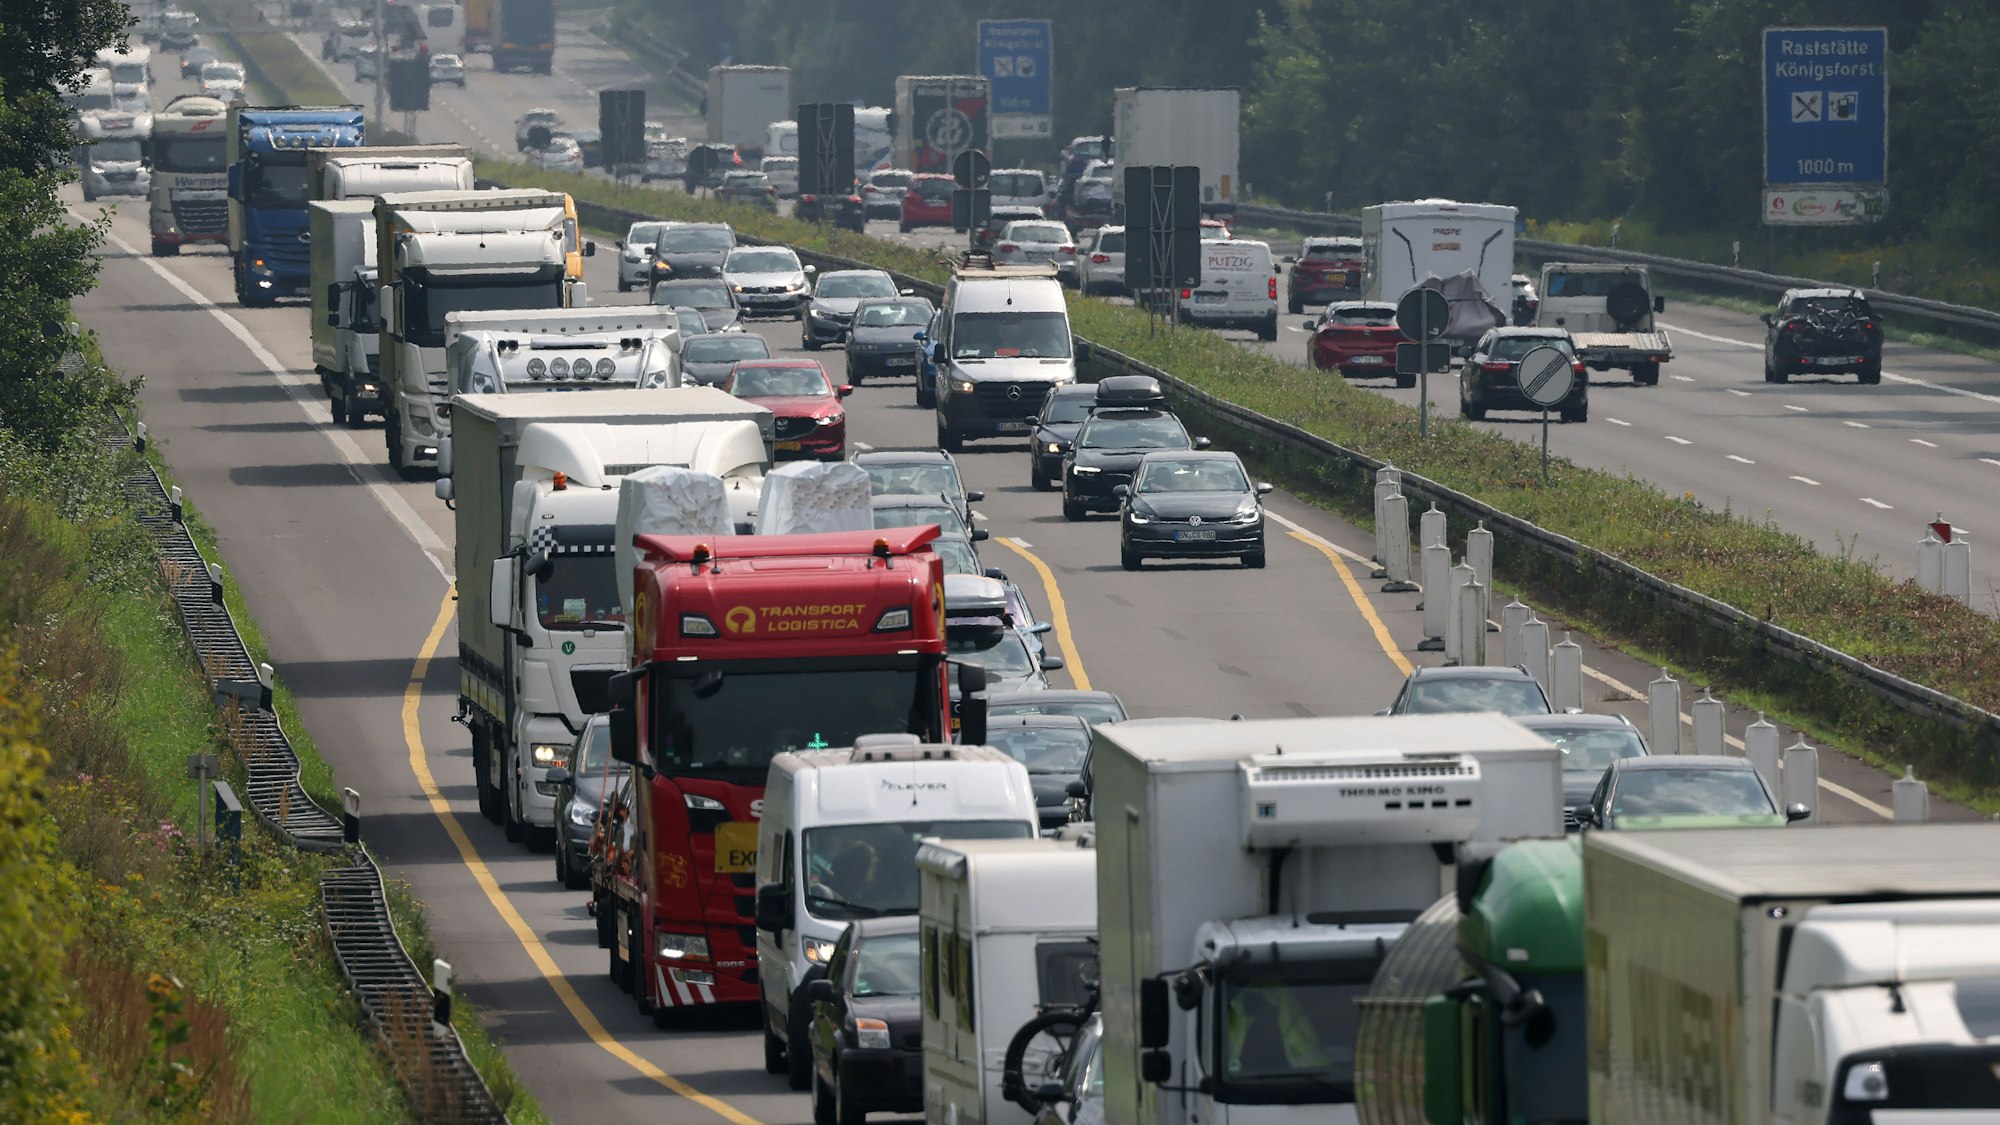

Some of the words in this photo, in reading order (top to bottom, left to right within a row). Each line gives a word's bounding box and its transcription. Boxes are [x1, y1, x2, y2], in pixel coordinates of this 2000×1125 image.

[1781, 39, 1868, 55] Raststätte
[1775, 61, 1875, 80] Königsforst
[1797, 158, 1834, 174] 1000
[1838, 162, 1854, 173] m
[1208, 256, 1254, 267] PUTZIG
[760, 604, 866, 617] TRANSPORT
[768, 619, 859, 632] LOGISTICA
[1338, 787, 1402, 798] THERMO
[1406, 786, 1445, 796] KING
[729, 849, 757, 867] EX
